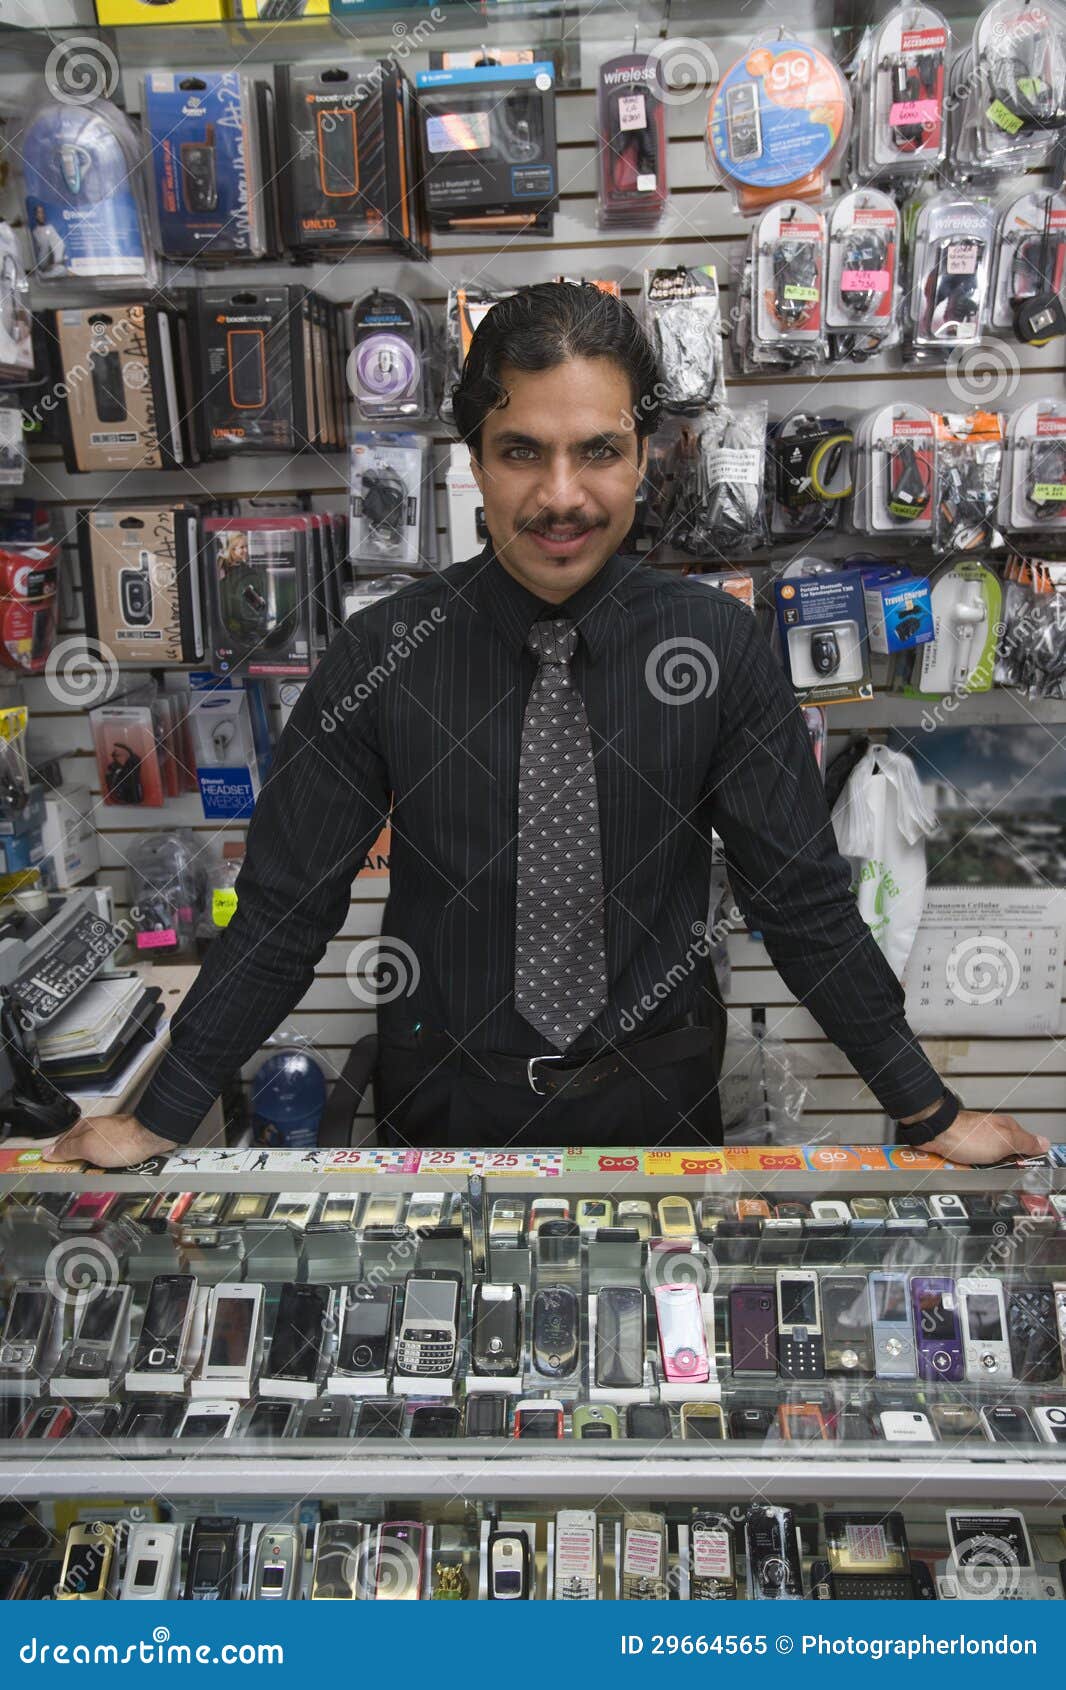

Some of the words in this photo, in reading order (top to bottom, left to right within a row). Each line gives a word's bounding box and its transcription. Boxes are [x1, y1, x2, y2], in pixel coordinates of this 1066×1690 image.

[604, 67, 656, 84] wireless
[772, 57, 810, 91] go
[303, 219, 336, 230] UNLTD
[935, 215, 986, 229] wireless
[203, 785, 250, 795] HEADSET
[648, 1151, 672, 1159] 300
[819, 1151, 848, 1163] go
[900, 1150, 929, 1162] go
